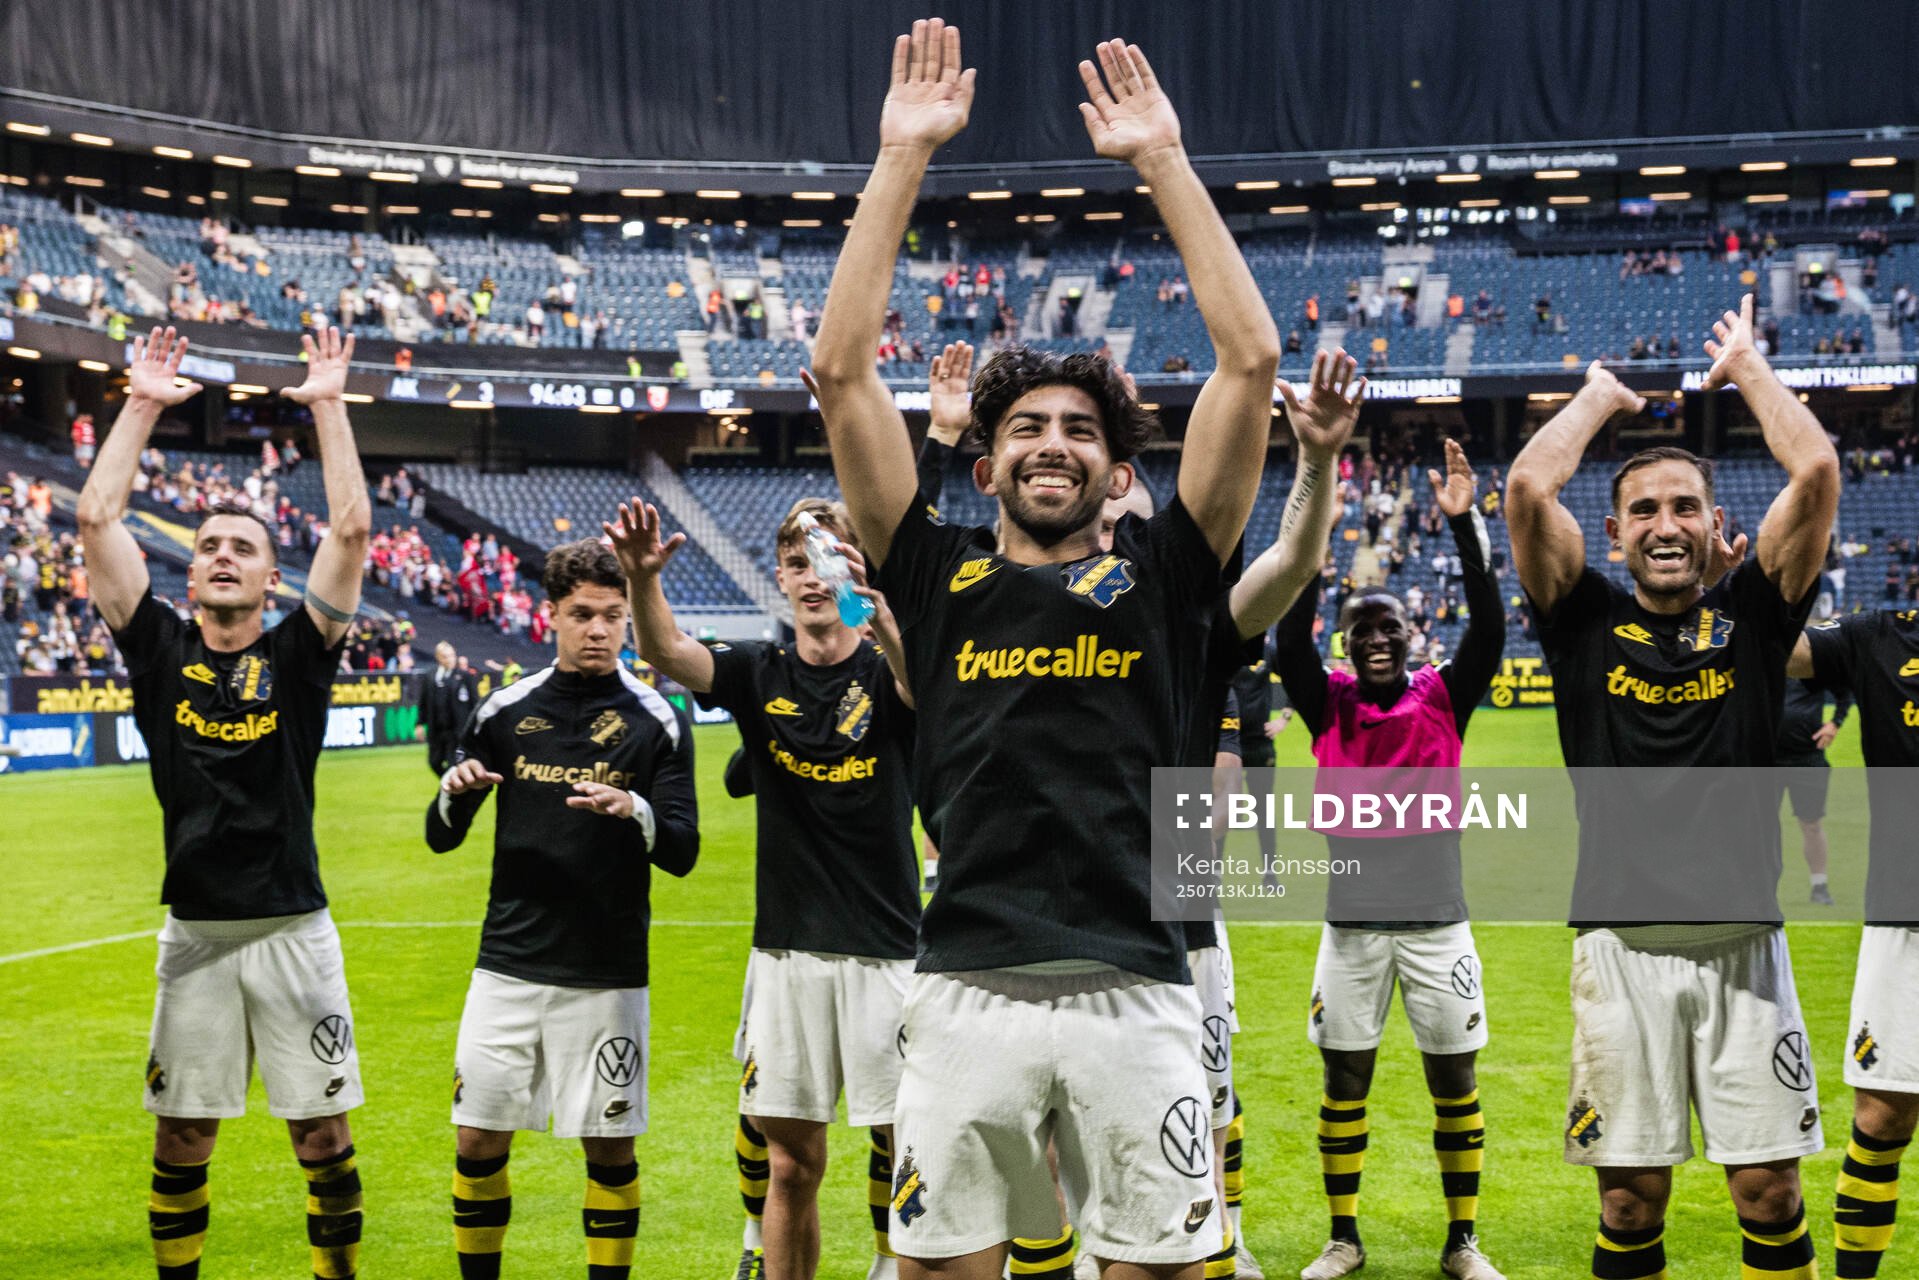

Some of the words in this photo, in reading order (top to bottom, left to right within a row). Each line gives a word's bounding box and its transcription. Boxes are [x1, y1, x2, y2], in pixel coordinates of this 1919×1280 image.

[478, 381, 495, 403] 3
[958, 557, 993, 578] NIKE
[955, 634, 1143, 682] truecaller
[1606, 664, 1736, 704] truecaller
[175, 699, 279, 742] truecaller
[513, 754, 636, 787] truecaller
